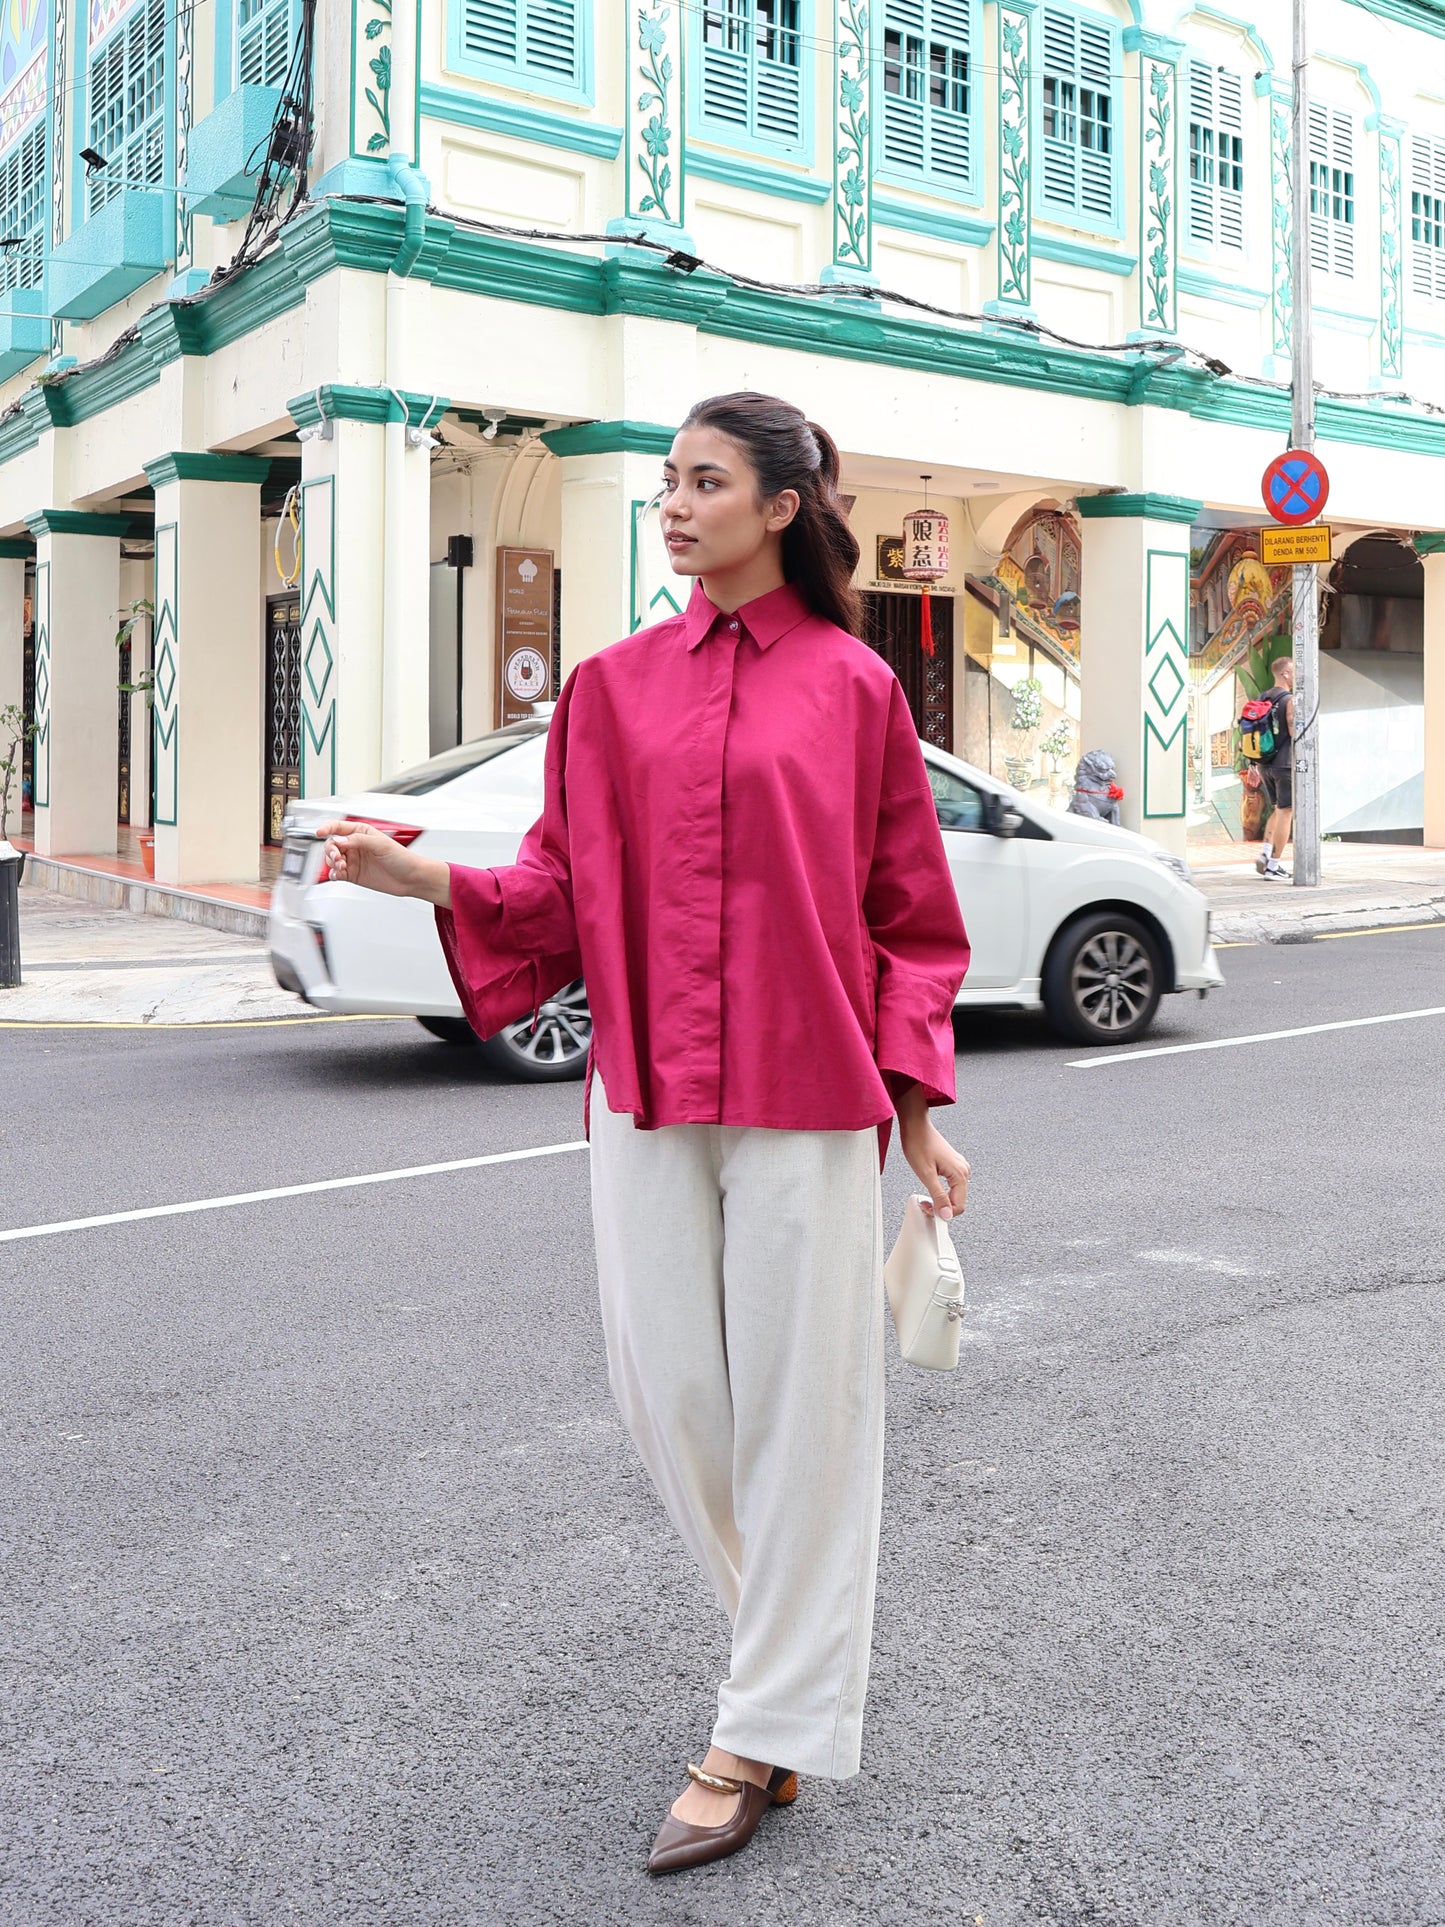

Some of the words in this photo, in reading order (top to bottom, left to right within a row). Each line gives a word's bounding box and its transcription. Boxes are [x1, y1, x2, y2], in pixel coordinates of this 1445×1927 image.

[912, 519, 933, 567] 娘惹
[1264, 537, 1295, 546] DILARANG
[1296, 535, 1326, 544] BERHENTI
[1273, 548, 1294, 556] DENDA
[1295, 547, 1304, 555] RM
[1306, 546, 1318, 554] 500
